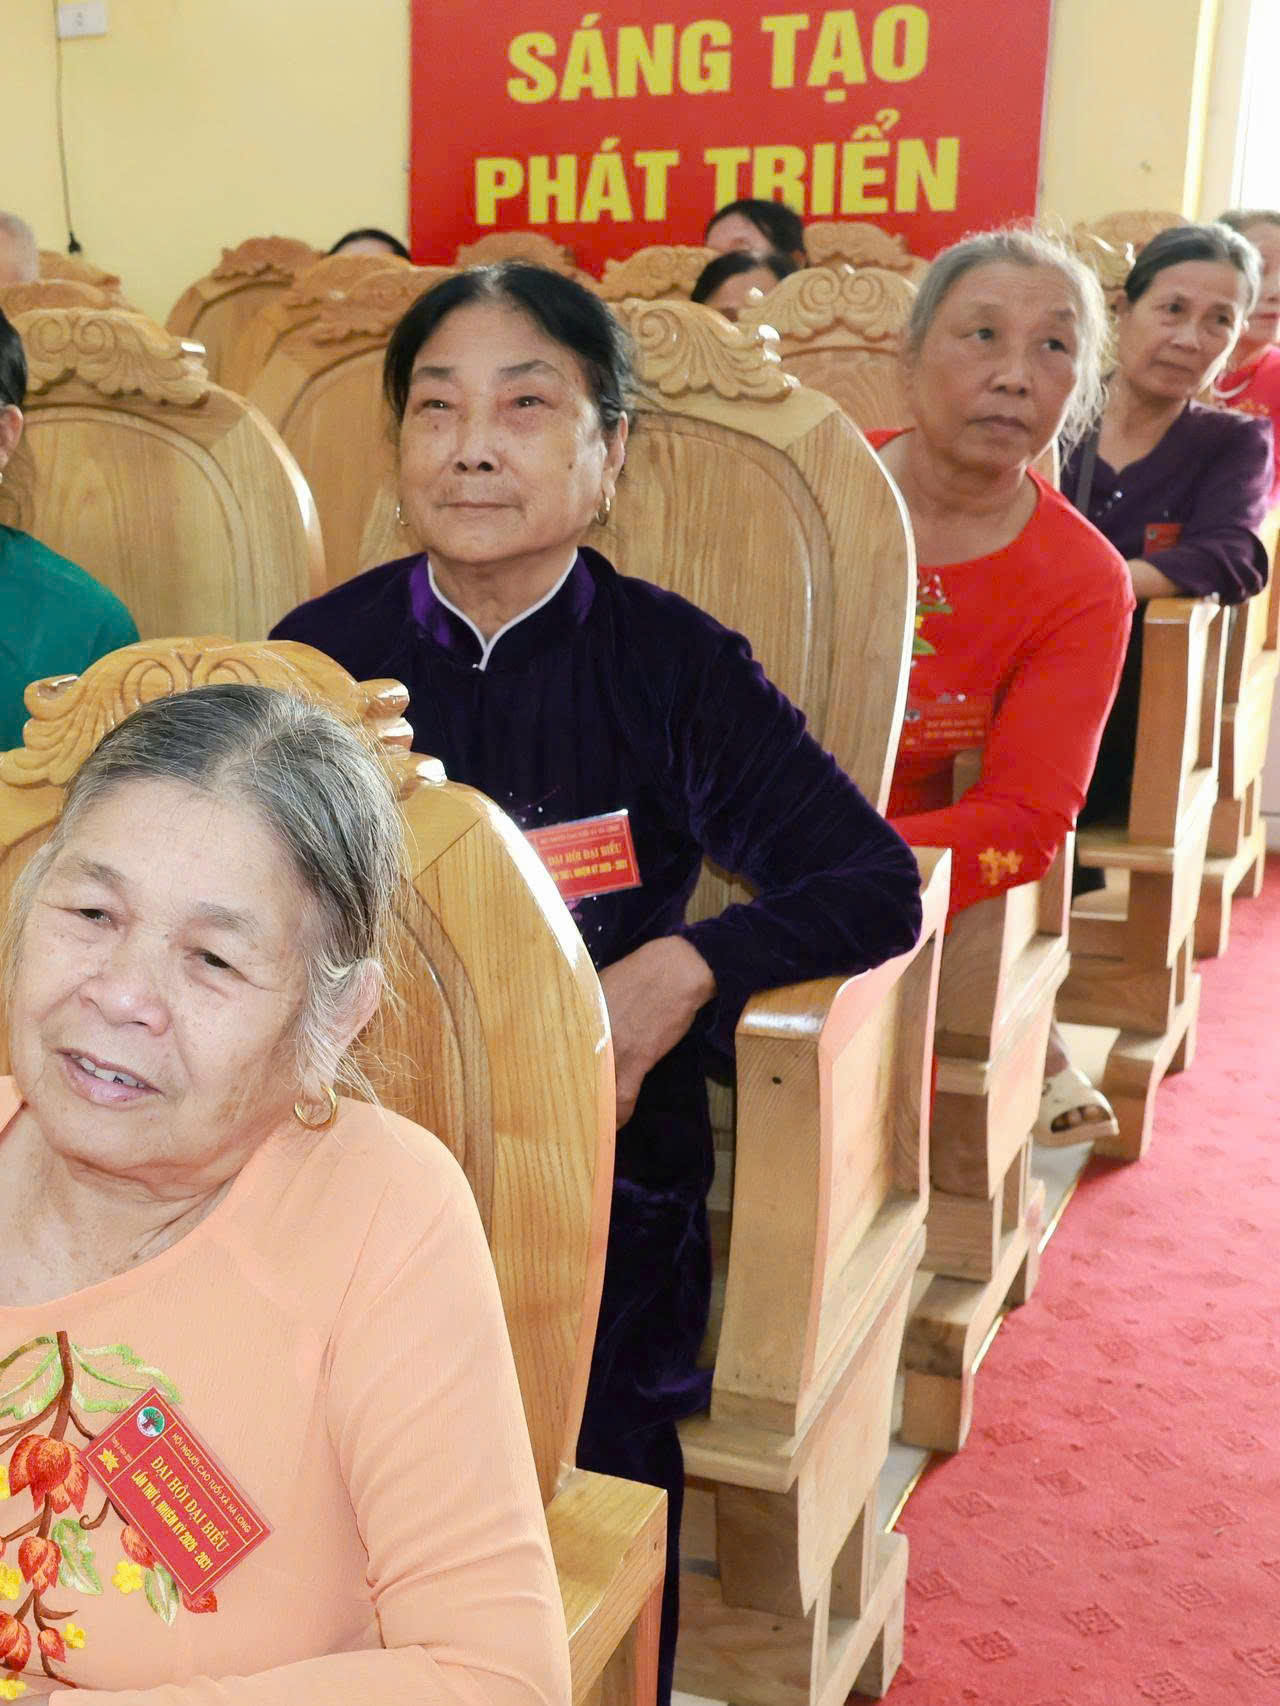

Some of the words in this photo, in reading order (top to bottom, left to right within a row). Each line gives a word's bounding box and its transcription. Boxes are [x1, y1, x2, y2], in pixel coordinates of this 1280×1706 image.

[507, 13, 732, 104] SÁNG
[761, 4, 930, 103] TẠO
[474, 136, 680, 226] PHÁT
[704, 108, 960, 216] TRIỂN
[151, 1456, 174, 1481] ĐẠI
[167, 1477, 191, 1503] HỘI
[184, 1499, 208, 1525] ĐẠI
[201, 1520, 230, 1552] BIỂU
[197, 1465, 211, 1480] CAO
[235, 1513, 252, 1533] LONG
[195, 1552, 213, 1571] 2031
